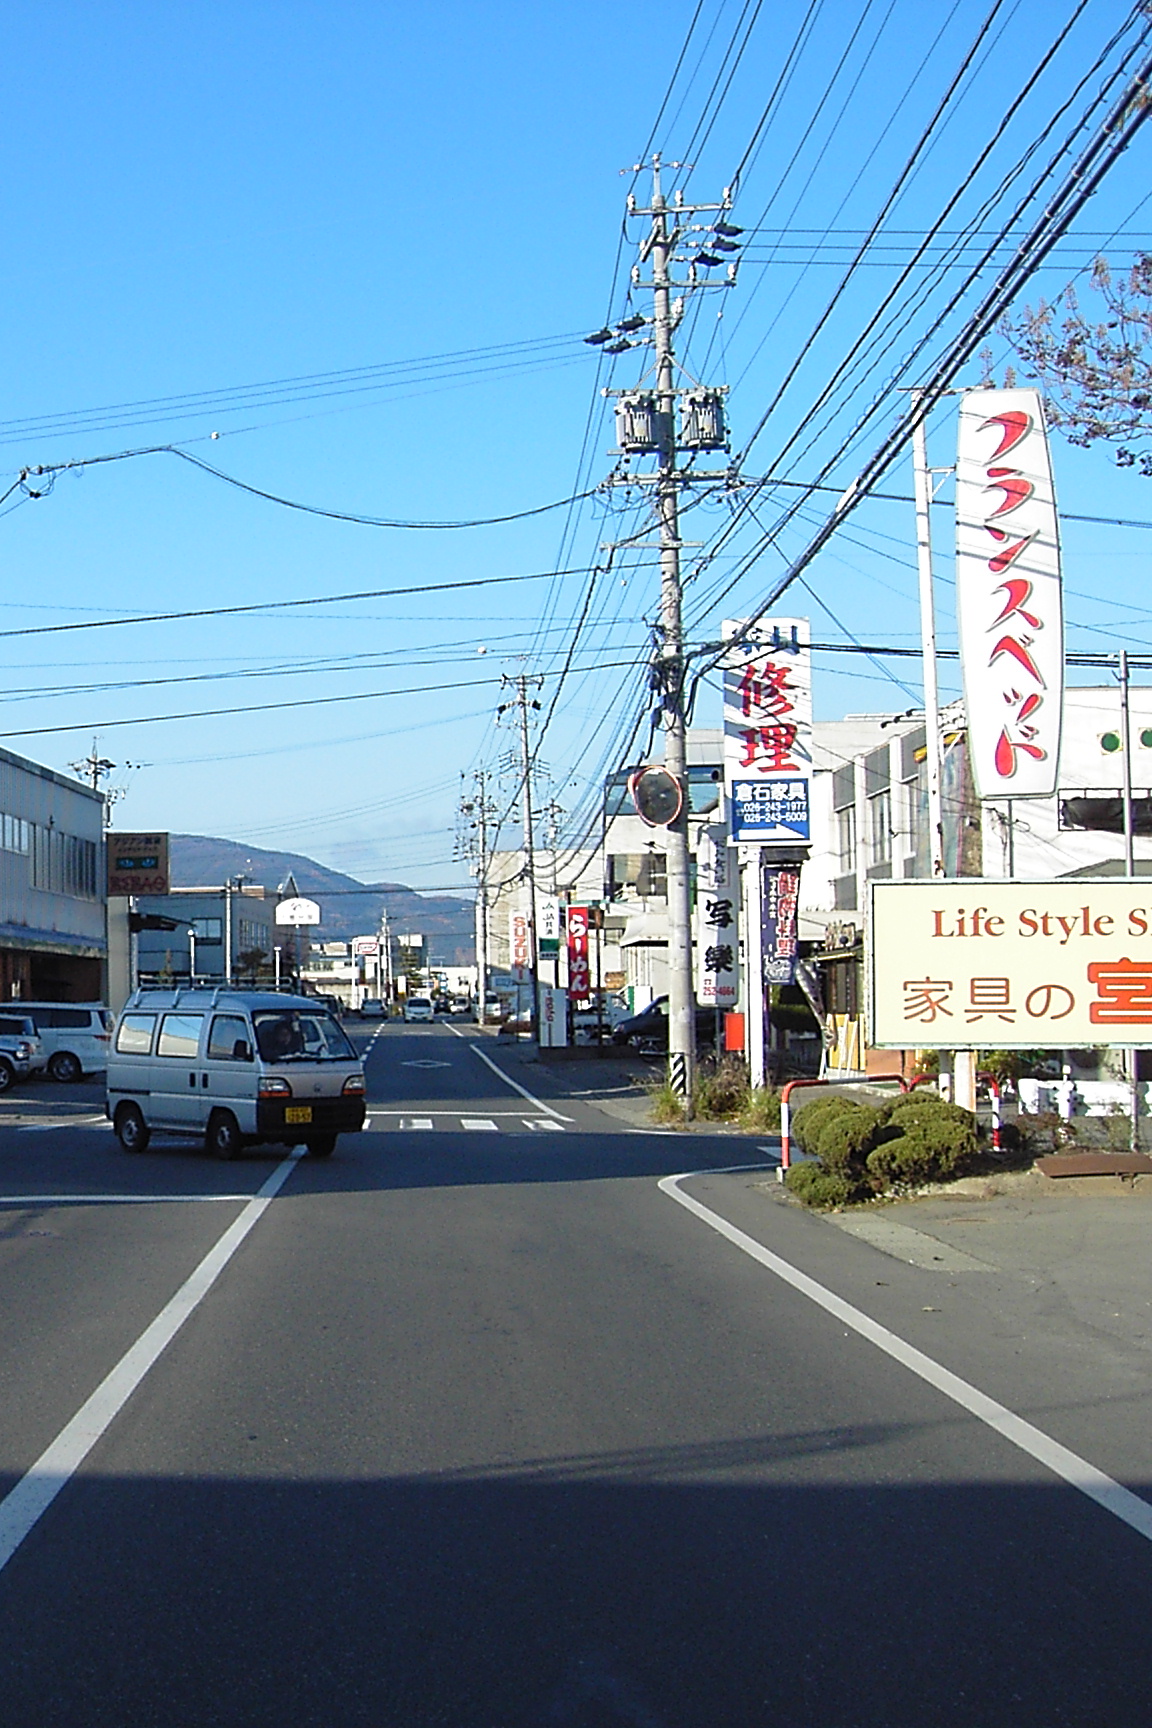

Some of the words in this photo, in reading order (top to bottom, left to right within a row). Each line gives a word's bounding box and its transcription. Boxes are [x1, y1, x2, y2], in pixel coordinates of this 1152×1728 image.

[975, 410, 1048, 778] フランスベッド
[737, 661, 800, 772] 修理
[735, 782, 806, 801] 倉石家具
[513, 916, 526, 980] SUZUKI
[569, 914, 588, 991] らーめん
[931, 907, 1004, 937] Life
[1018, 906, 1114, 945] Style
[1128, 907, 1152, 937] S
